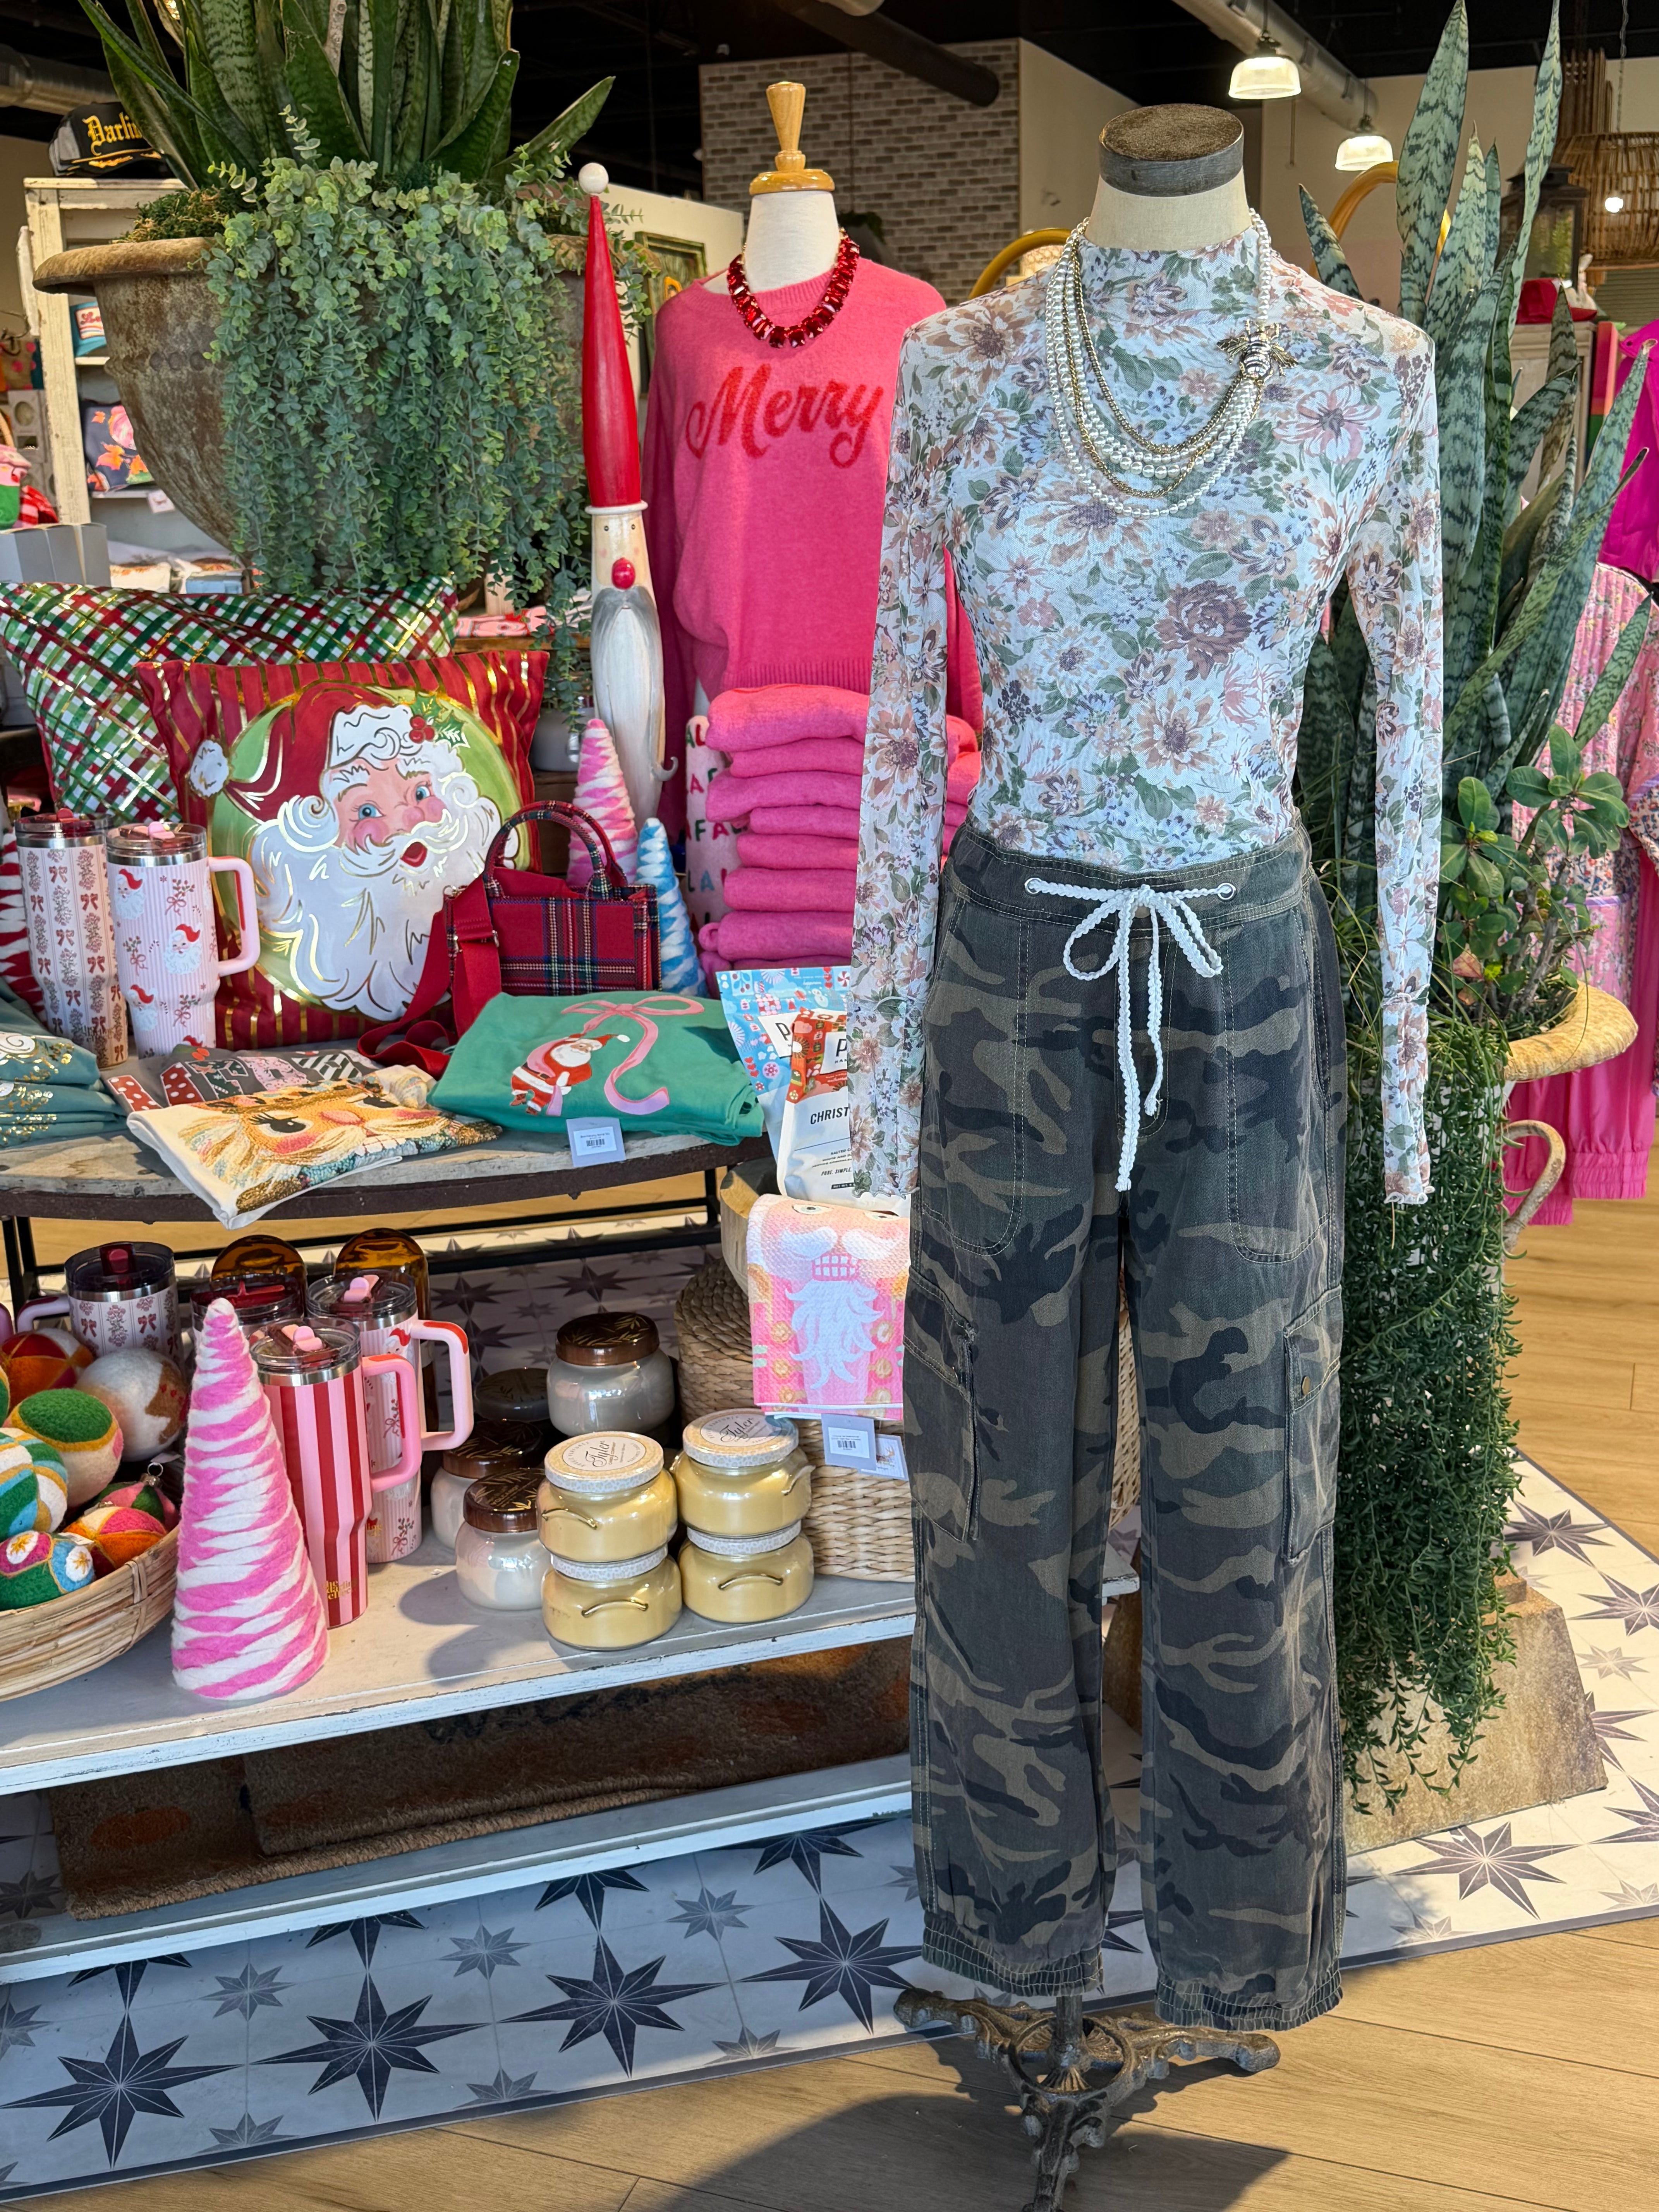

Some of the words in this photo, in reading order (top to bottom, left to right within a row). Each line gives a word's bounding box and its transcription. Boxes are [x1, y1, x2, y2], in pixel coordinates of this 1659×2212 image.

[686, 363, 884, 468] Merry
[810, 1106, 849, 1125] CHRIST
[720, 1417, 754, 1443] Tyler
[585, 1440, 619, 1467] Tyler
